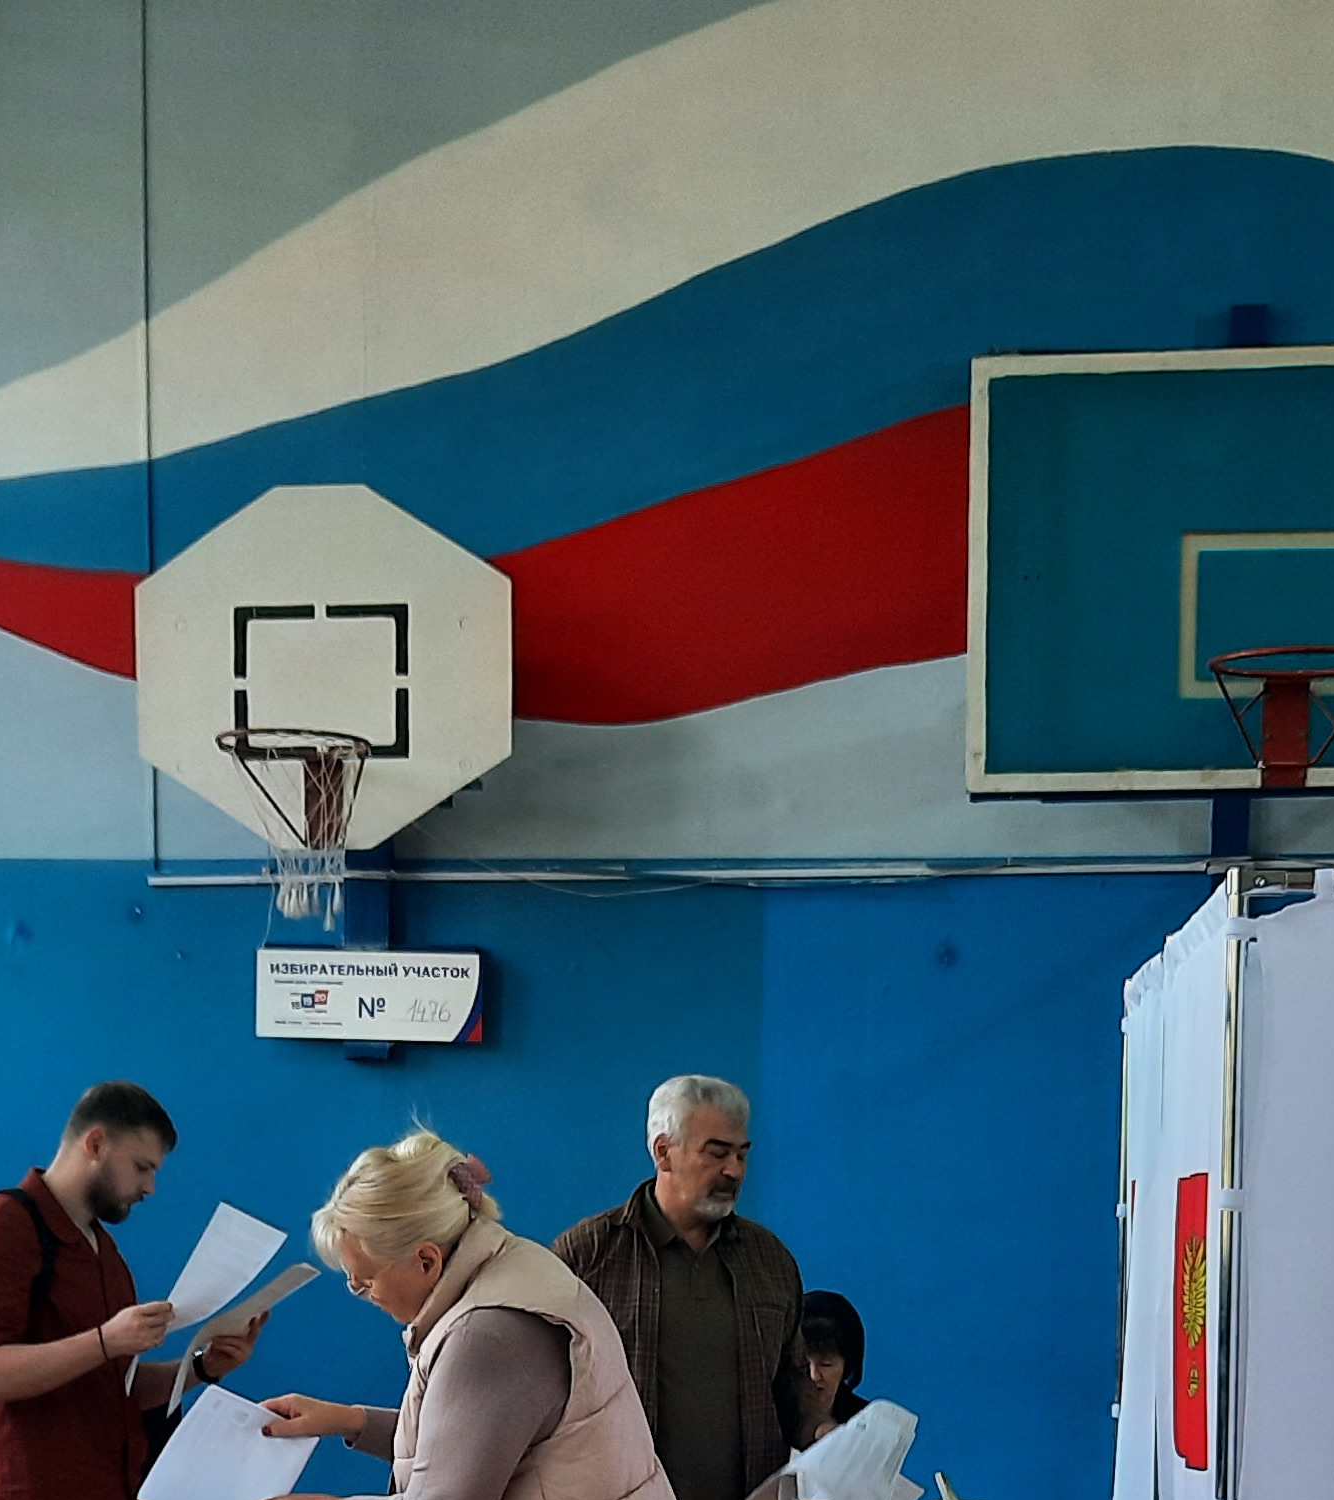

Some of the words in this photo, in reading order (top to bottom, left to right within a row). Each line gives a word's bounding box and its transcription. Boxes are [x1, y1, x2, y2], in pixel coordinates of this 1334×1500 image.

[269, 962, 398, 978] ИЗБИРАТЕЛЬНЫЙ
[402, 965, 471, 979] УЧАСТОК
[358, 996, 386, 1019] №
[407, 998, 451, 1022] 1476
